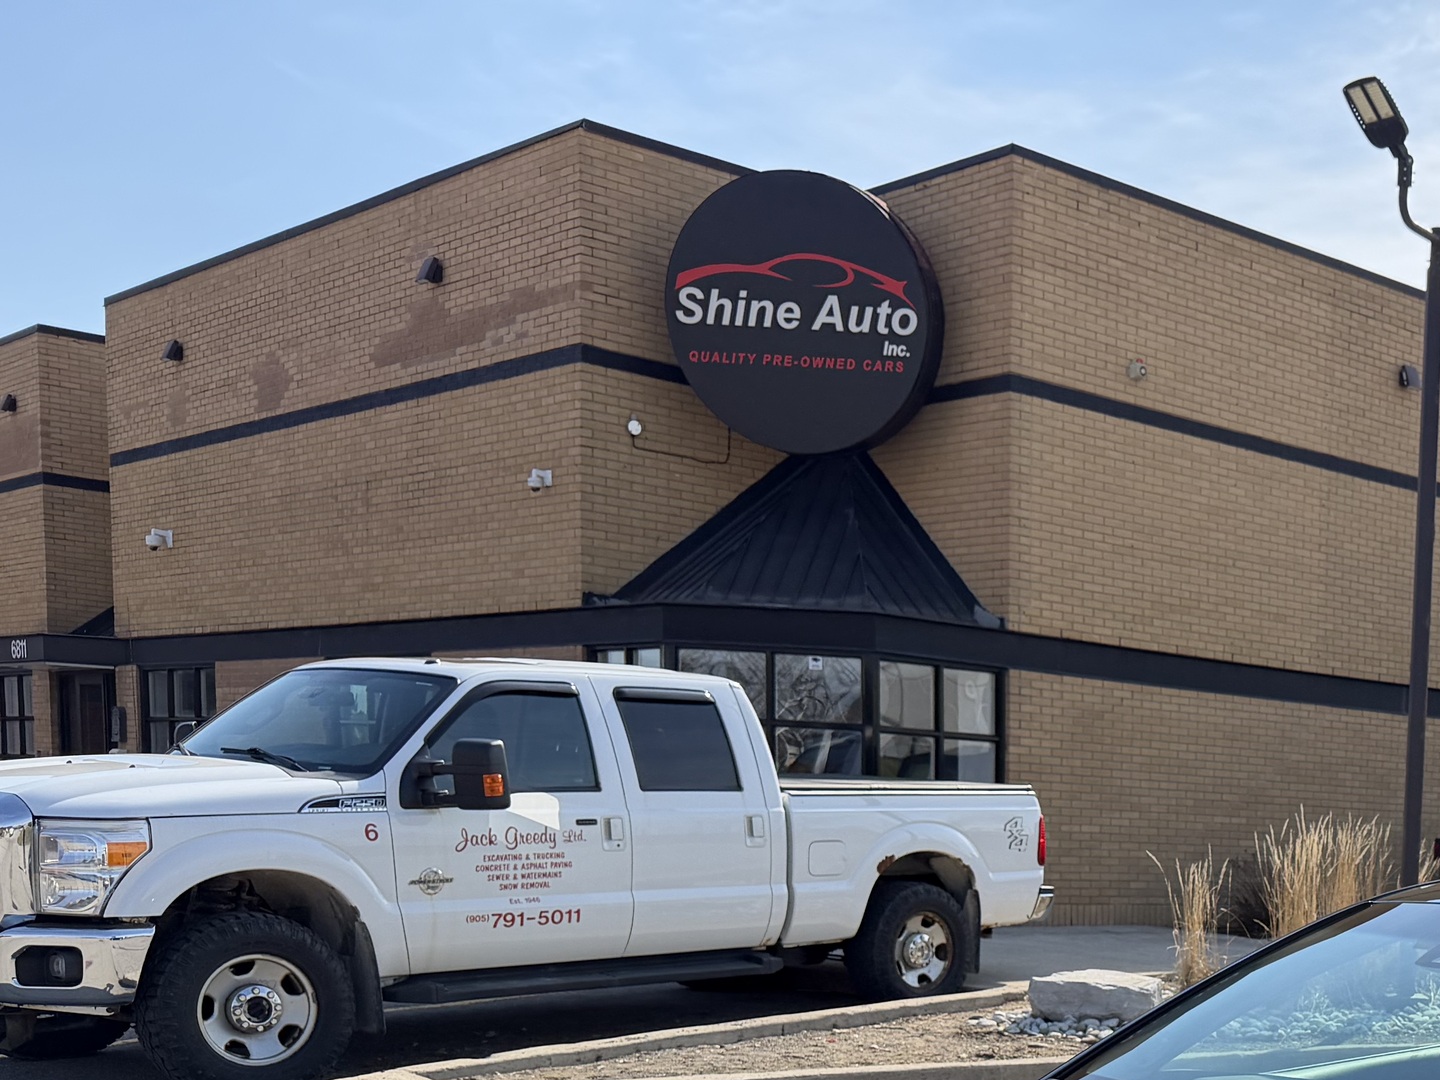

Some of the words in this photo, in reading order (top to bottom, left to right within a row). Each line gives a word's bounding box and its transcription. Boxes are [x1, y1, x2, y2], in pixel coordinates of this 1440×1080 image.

[675, 286, 801, 330] Shine
[811, 295, 918, 336] Auto
[883, 340, 911, 358] Inc.
[688, 350, 756, 365] QUALITY
[762, 354, 856, 370] PRE-OWNED
[863, 359, 905, 373] CARS
[11, 639, 27, 659] 6811
[364, 823, 379, 842] 6
[455, 827, 498, 853] Jack
[504, 826, 557, 850] Greedy
[483, 853, 523, 863] EXCAVATING
[533, 851, 566, 860] TRUCKING
[475, 863, 511, 873] CONCRETE
[520, 862, 548, 871] ASPHALT
[550, 861, 573, 869] PAVING
[487, 873, 511, 882] SEWER
[520, 871, 562, 880] WATERMAINS
[499, 883, 519, 891] SNOW
[520, 881, 551, 890] REMOVAL
[491, 908, 581, 929] 791-5011
